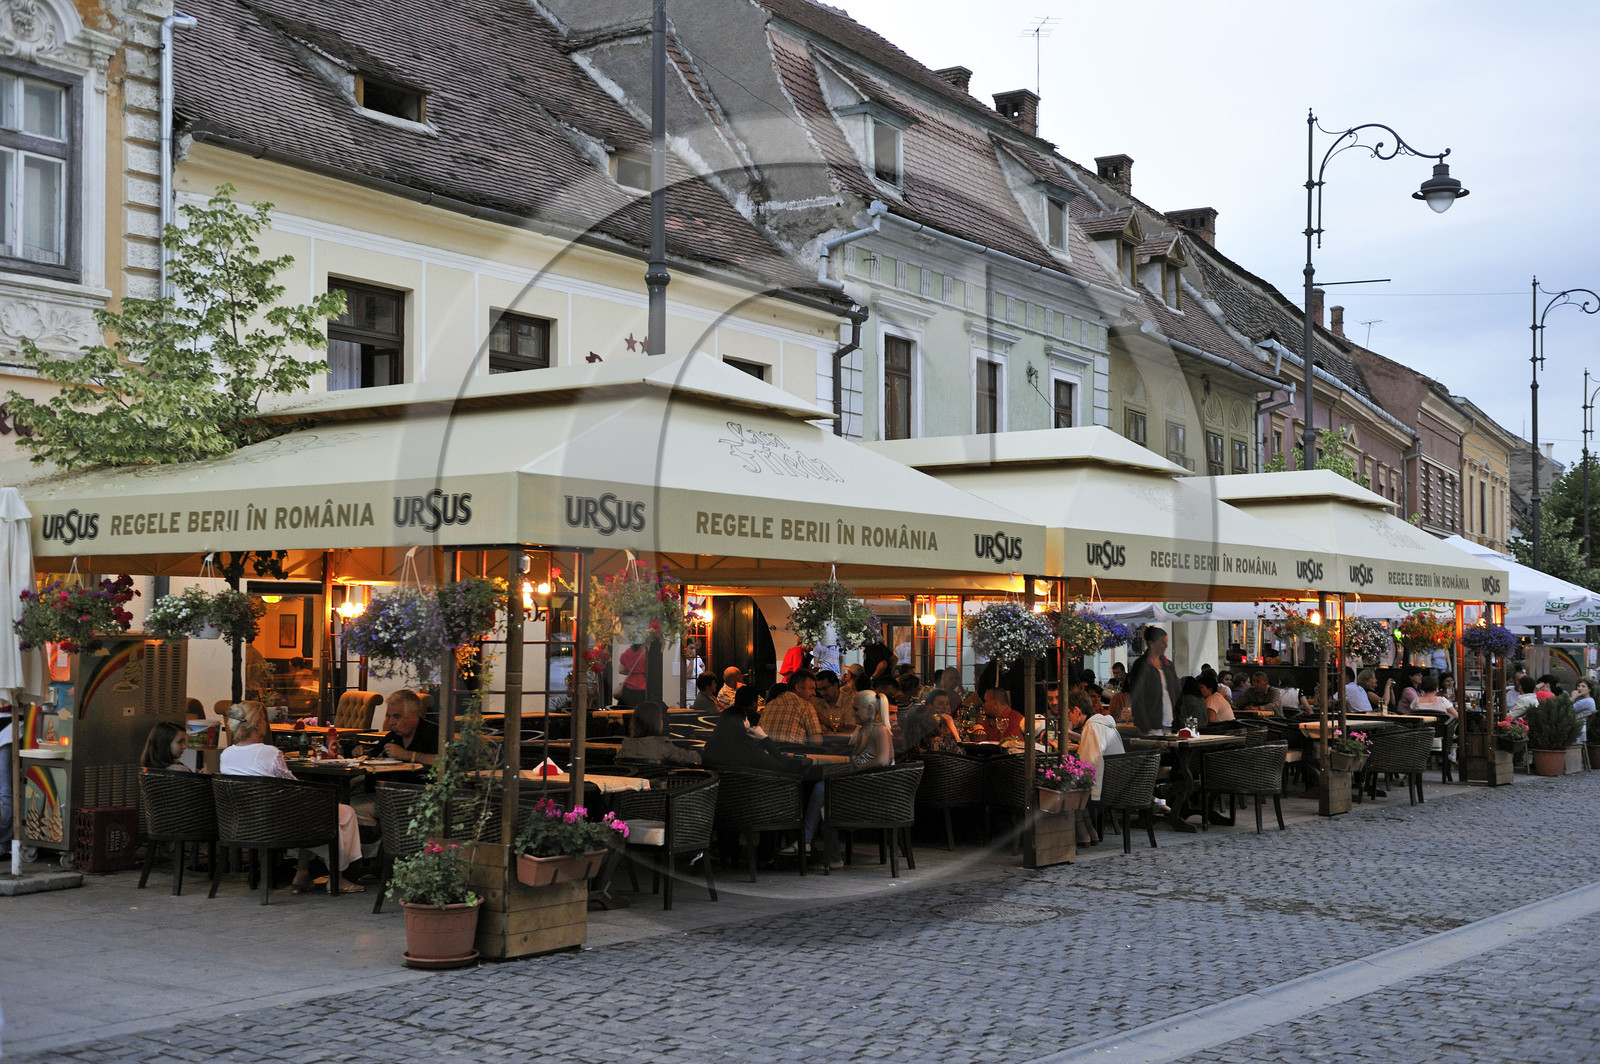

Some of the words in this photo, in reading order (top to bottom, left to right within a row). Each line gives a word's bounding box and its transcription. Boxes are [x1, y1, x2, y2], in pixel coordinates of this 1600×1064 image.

[42, 508, 99, 545] URSUS
[110, 511, 180, 536] REGELE
[187, 509, 239, 532] BERII
[246, 503, 267, 531] ÎN
[275, 499, 374, 529] ROMÂNIA
[393, 488, 472, 533] URSUS
[564, 493, 646, 536] URSUS
[696, 511, 774, 539] REGELE
[781, 518, 830, 544] BERII
[837, 519, 855, 546] ÎN
[861, 524, 938, 551] ROMÂNIA
[974, 531, 1022, 564] URSUS
[1086, 540, 1126, 571] URSUS
[1150, 550, 1190, 570] REGELE
[1193, 554, 1219, 572] BERII
[1223, 553, 1232, 572] ÎN
[1235, 556, 1277, 576] ROMÂNIA
[1296, 558, 1323, 583] URSUS
[1349, 563, 1373, 587] URSUS
[1388, 571, 1413, 586] REGELE
[1415, 574, 1432, 586] BERII
[1433, 572, 1441, 587] ÎN
[1441, 574, 1470, 590] ROMÂNIA
[1481, 575, 1500, 596] URSUS
